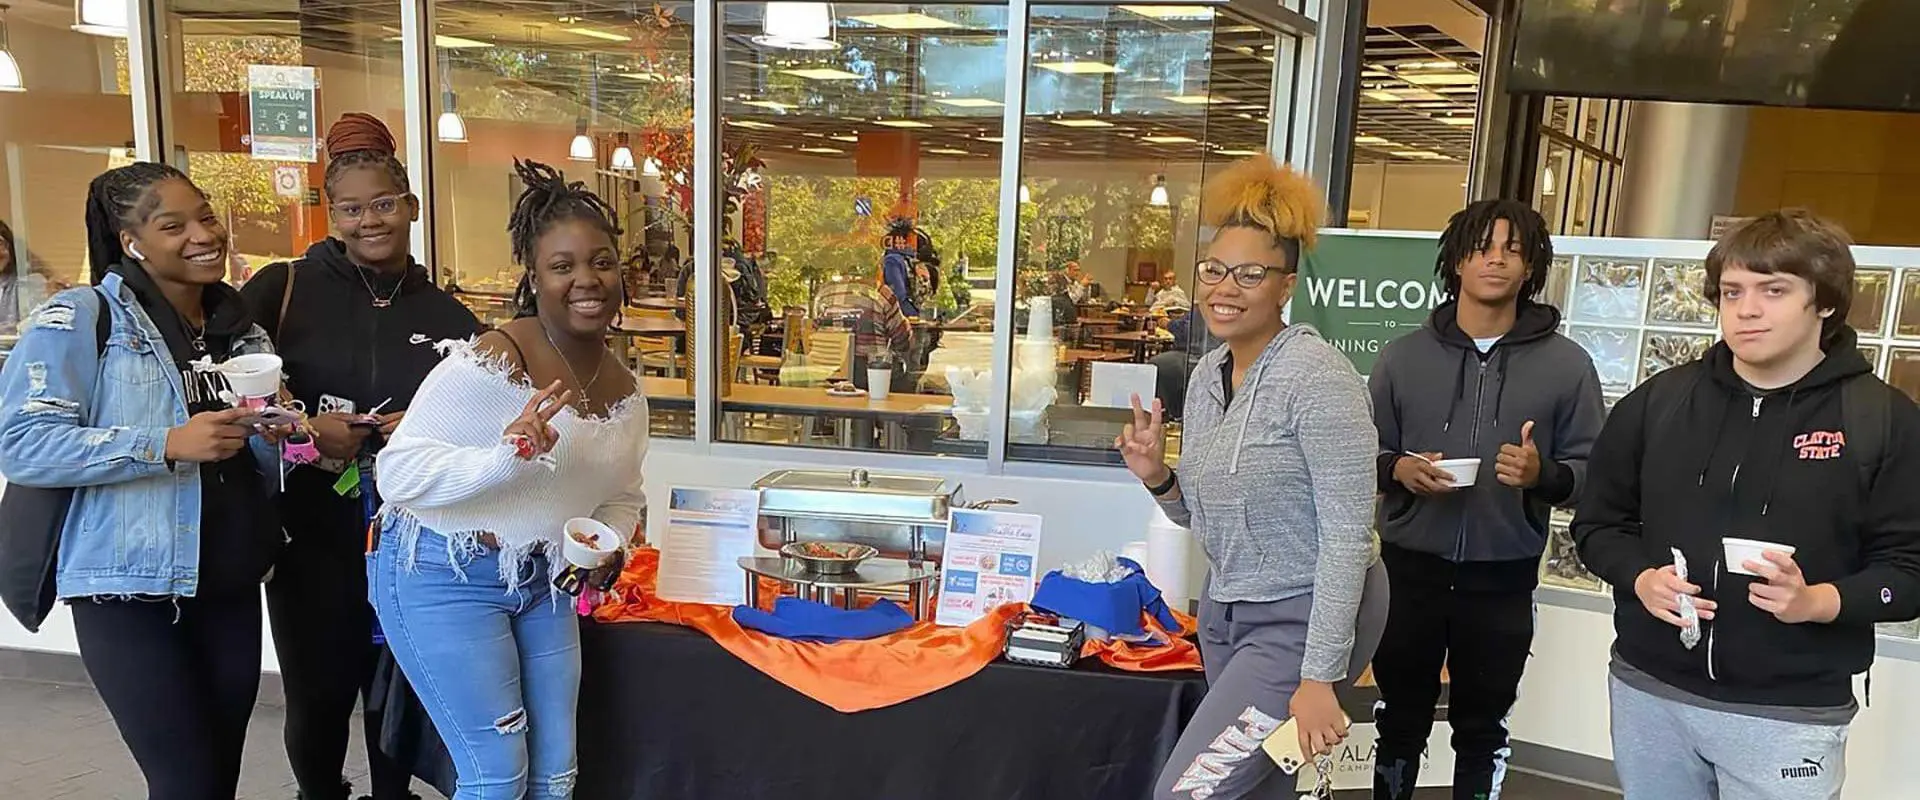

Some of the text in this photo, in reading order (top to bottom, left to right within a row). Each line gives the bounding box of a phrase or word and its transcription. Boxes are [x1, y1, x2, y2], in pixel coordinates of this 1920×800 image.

[258, 90, 289, 100] SPEAK
[1306, 276, 1455, 310] WELCOM
[1384, 320, 1396, 328] TO
[1798, 444, 1840, 460] STATE
[1340, 764, 1374, 773] CAMP
[1781, 766, 1818, 779] PUMA
